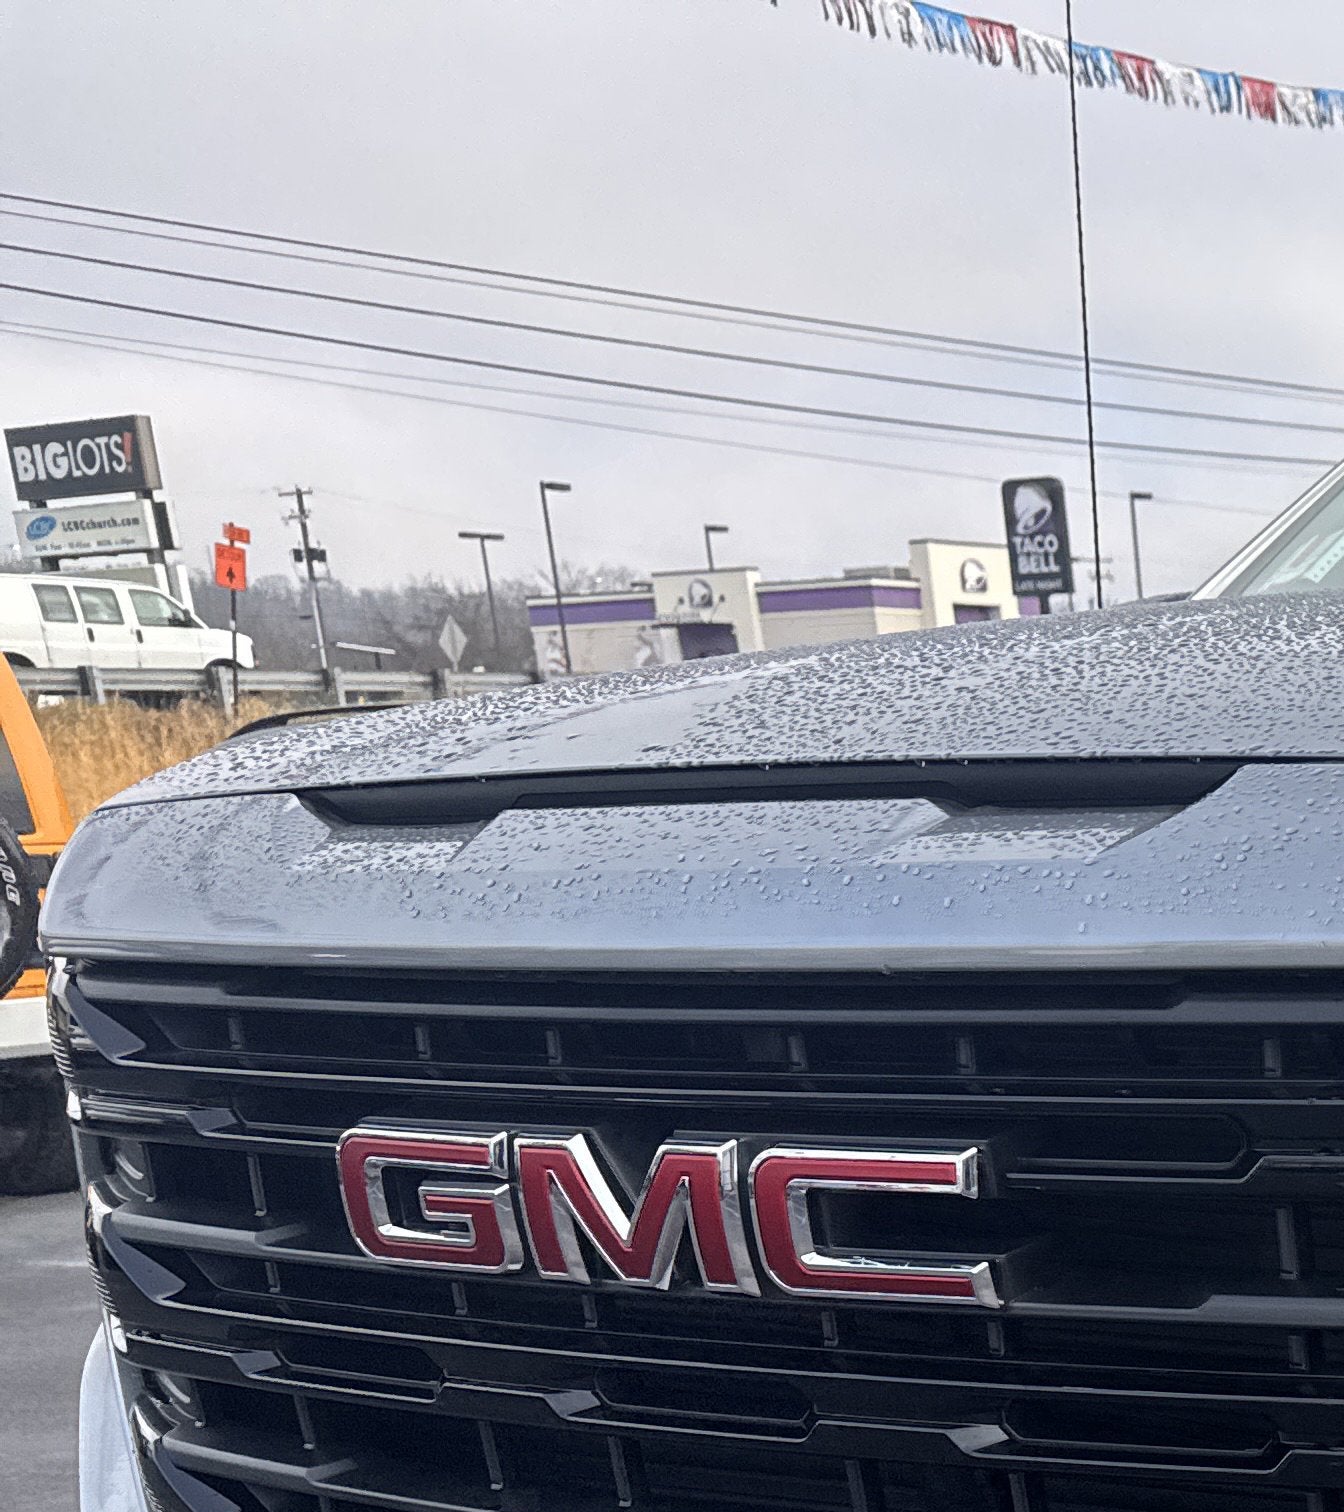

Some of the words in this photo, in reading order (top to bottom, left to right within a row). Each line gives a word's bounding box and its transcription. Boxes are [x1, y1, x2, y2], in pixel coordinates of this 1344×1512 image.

[1012, 533, 1059, 554] TACO
[1018, 552, 1061, 574] BELL
[336, 1127, 1004, 1308] GMC
